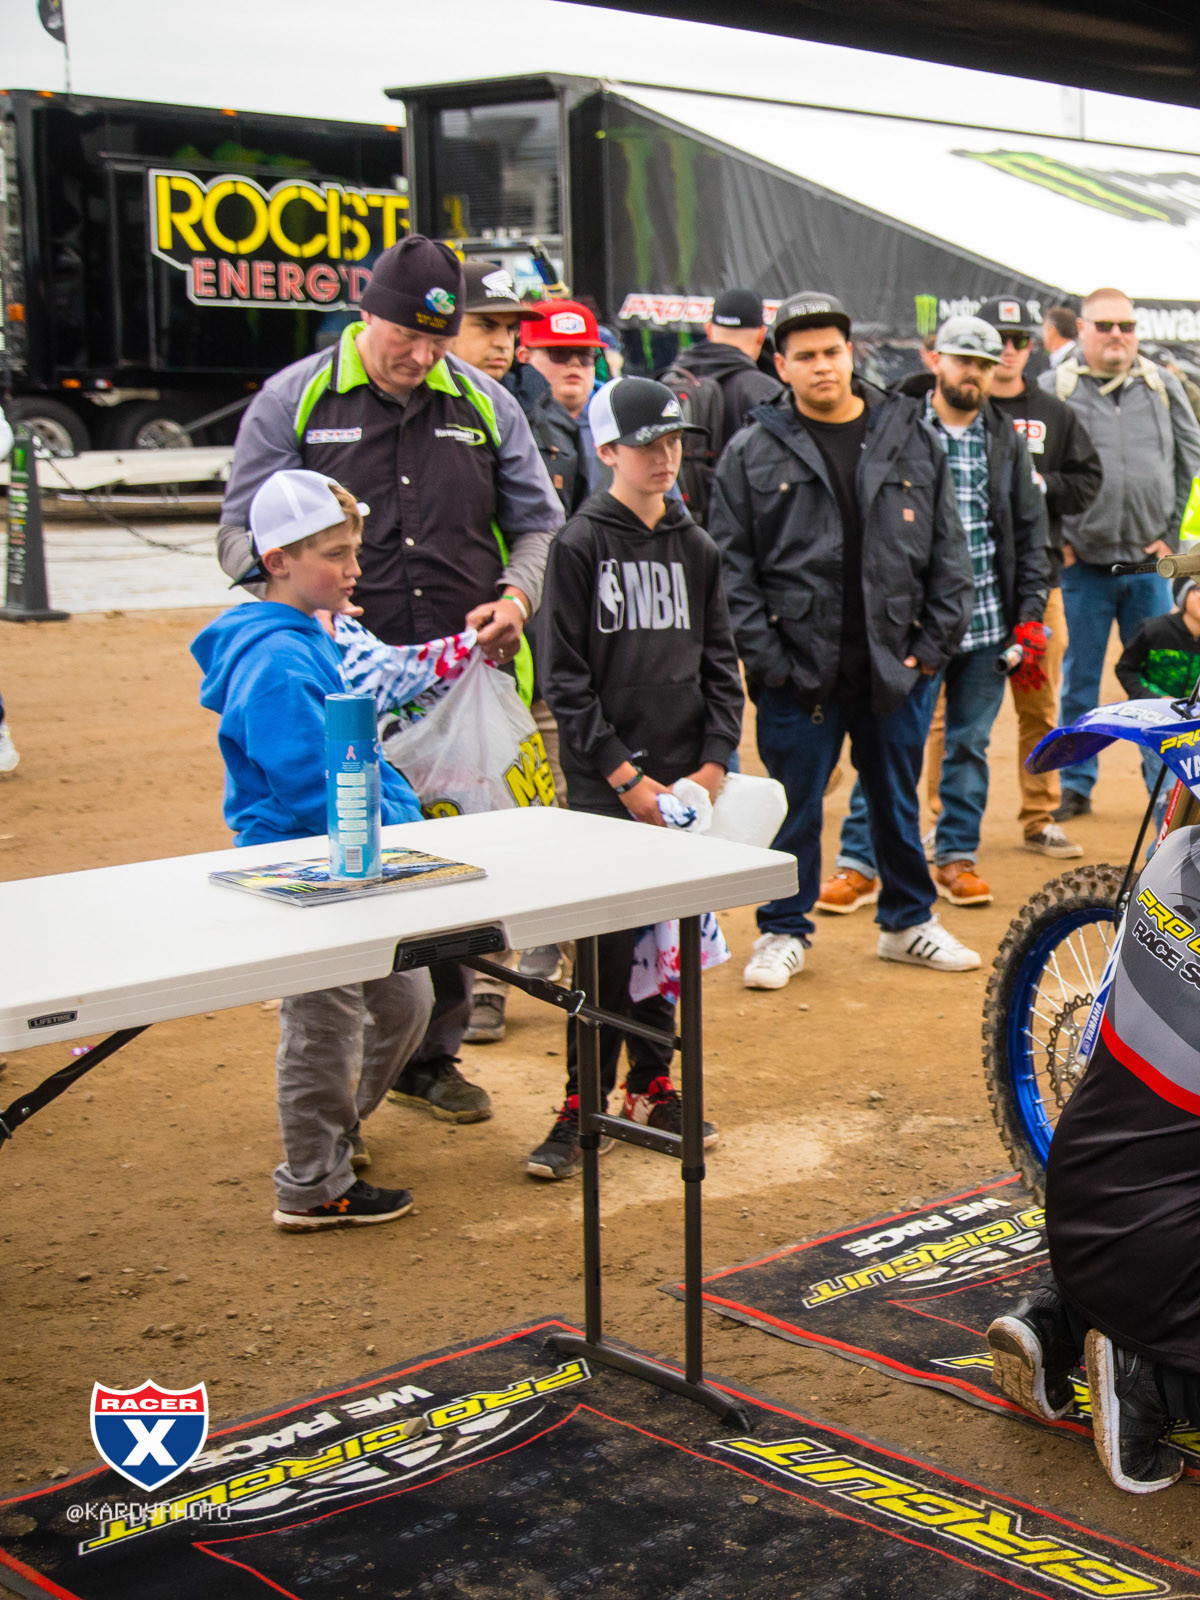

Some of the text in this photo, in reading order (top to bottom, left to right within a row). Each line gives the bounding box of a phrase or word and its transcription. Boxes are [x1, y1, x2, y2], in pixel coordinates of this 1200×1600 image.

[622, 560, 691, 630] NBA
[1135, 886, 1196, 942] PRO
[1132, 917, 1184, 971] RACE
[1084, 1000, 1104, 1042] YAMAHA
[841, 1214, 954, 1258] RACE
[945, 1197, 1012, 1222] WE
[801, 1218, 1024, 1310] CIRCUIT
[339, 1384, 435, 1419] WE
[423, 1357, 592, 1431] PRO
[708, 1435, 1172, 1598] CIRCUIT
